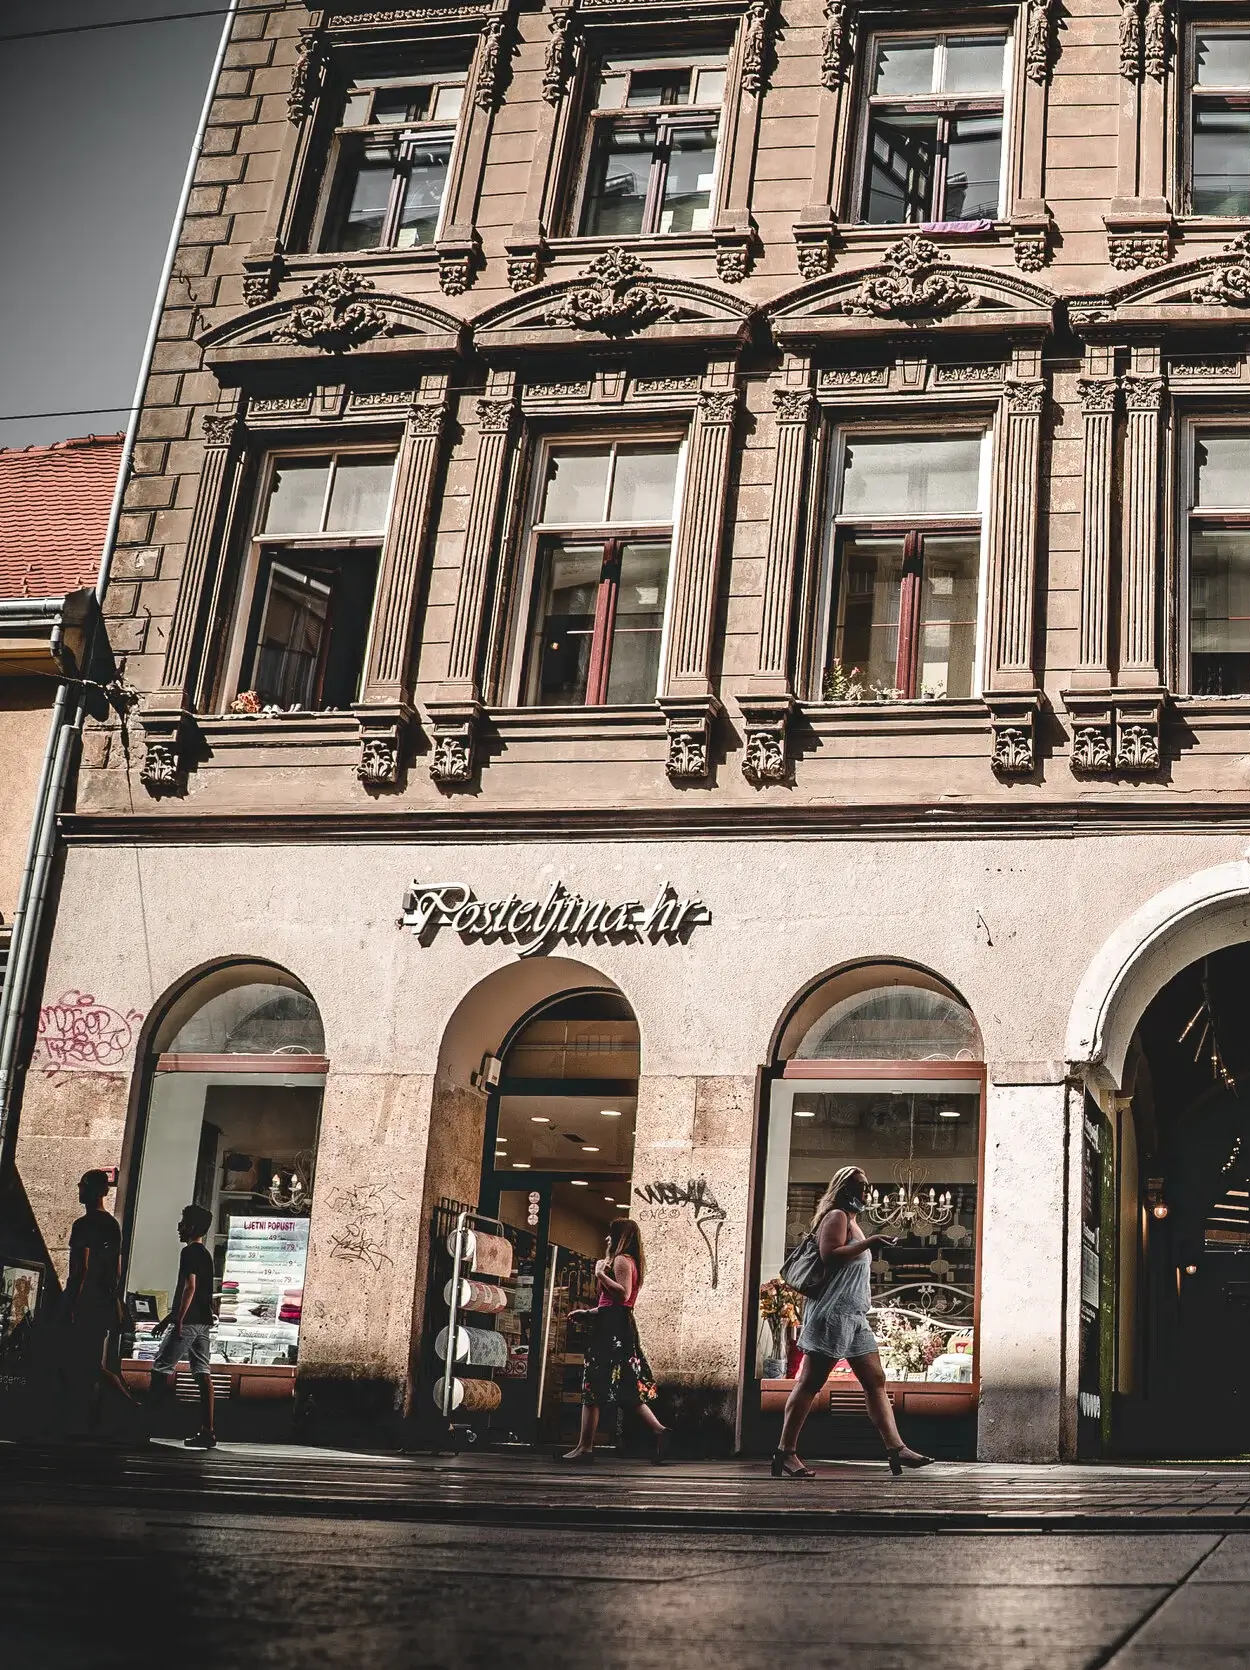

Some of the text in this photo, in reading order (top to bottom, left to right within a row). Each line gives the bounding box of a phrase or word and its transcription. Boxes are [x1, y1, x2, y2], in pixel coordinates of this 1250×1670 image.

[409, 880, 703, 955] Posteljina.hr
[244, 1220, 296, 1232] LJETNI POPUSTI
